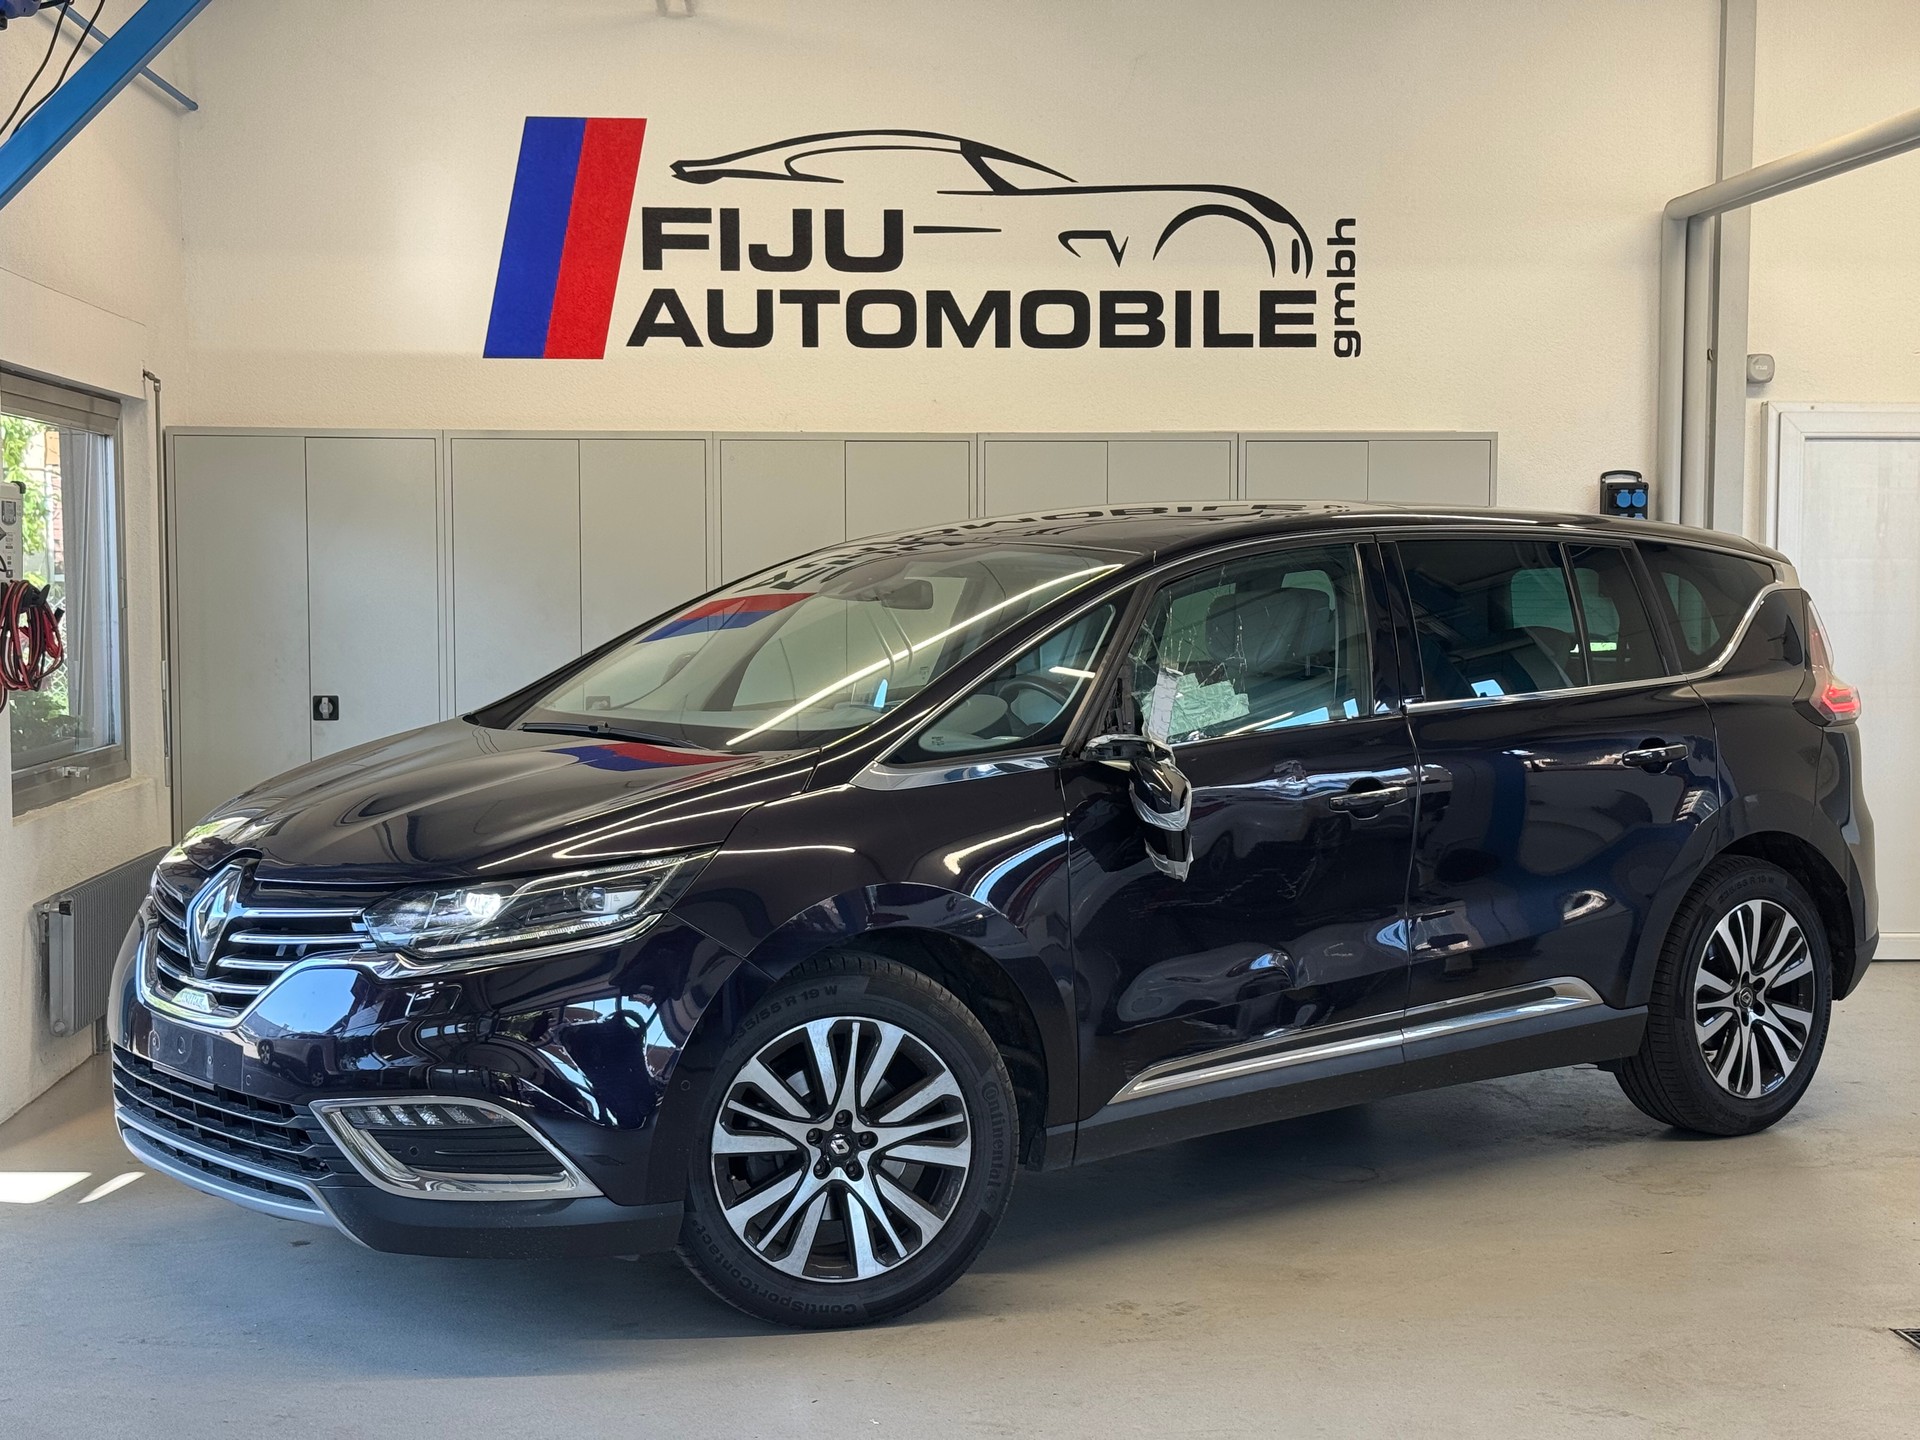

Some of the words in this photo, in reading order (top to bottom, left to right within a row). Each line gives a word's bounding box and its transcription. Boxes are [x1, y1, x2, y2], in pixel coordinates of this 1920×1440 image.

[642, 207, 903, 272] FIJU
[627, 289, 1316, 348] AUTOMOBILE
[1327, 219, 1361, 357] gmbh
[784, 995, 797, 1008] R
[801, 988, 820, 1001] 19
[824, 985, 838, 996] W
[981, 1081, 1005, 1188] Continental
